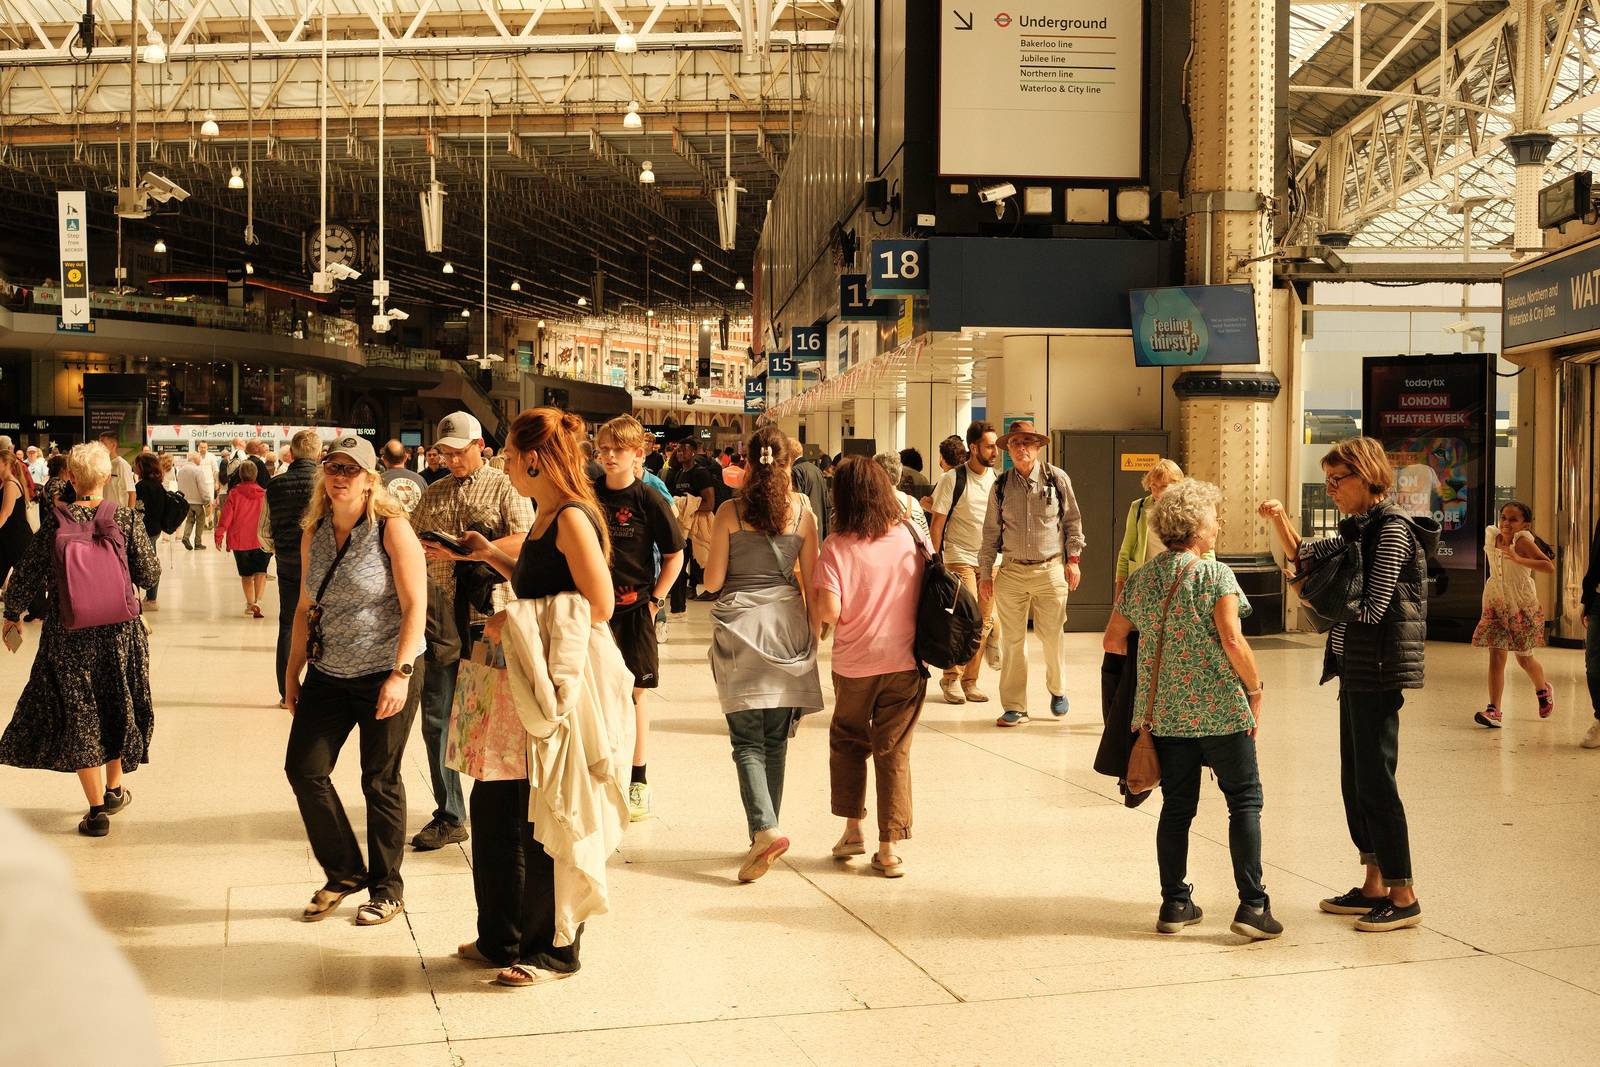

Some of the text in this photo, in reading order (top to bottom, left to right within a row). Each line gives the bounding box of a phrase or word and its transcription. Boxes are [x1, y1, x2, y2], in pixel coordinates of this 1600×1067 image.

[1019, 15, 1107, 30] Underground
[1020, 40, 1073, 48] Bakerloo line
[1020, 54, 1066, 63] Jubilee line
[1020, 69, 1074, 78] Northern line
[1020, 84, 1101, 95] Waterloo & City line
[880, 250, 920, 279] 18
[1527, 288, 1549, 304] Northern
[1549, 282, 1559, 298] and
[1571, 269, 1600, 310] WAT
[1508, 304, 1556, 326] Waterloo & City lines
[1153, 317, 1190, 334] feeling
[797, 333, 820, 351] 16
[1149, 332, 1200, 354] thirsty?
[772, 358, 791, 372] 15
[748, 382, 763, 394] 14
[1405, 378, 1445, 388] todaytix
[1401, 396, 1447, 406] LONDON
[1385, 413, 1465, 424] THEATRE WEEK
[192, 429, 244, 438] Self-service
[1437, 548, 1454, 556] £35
